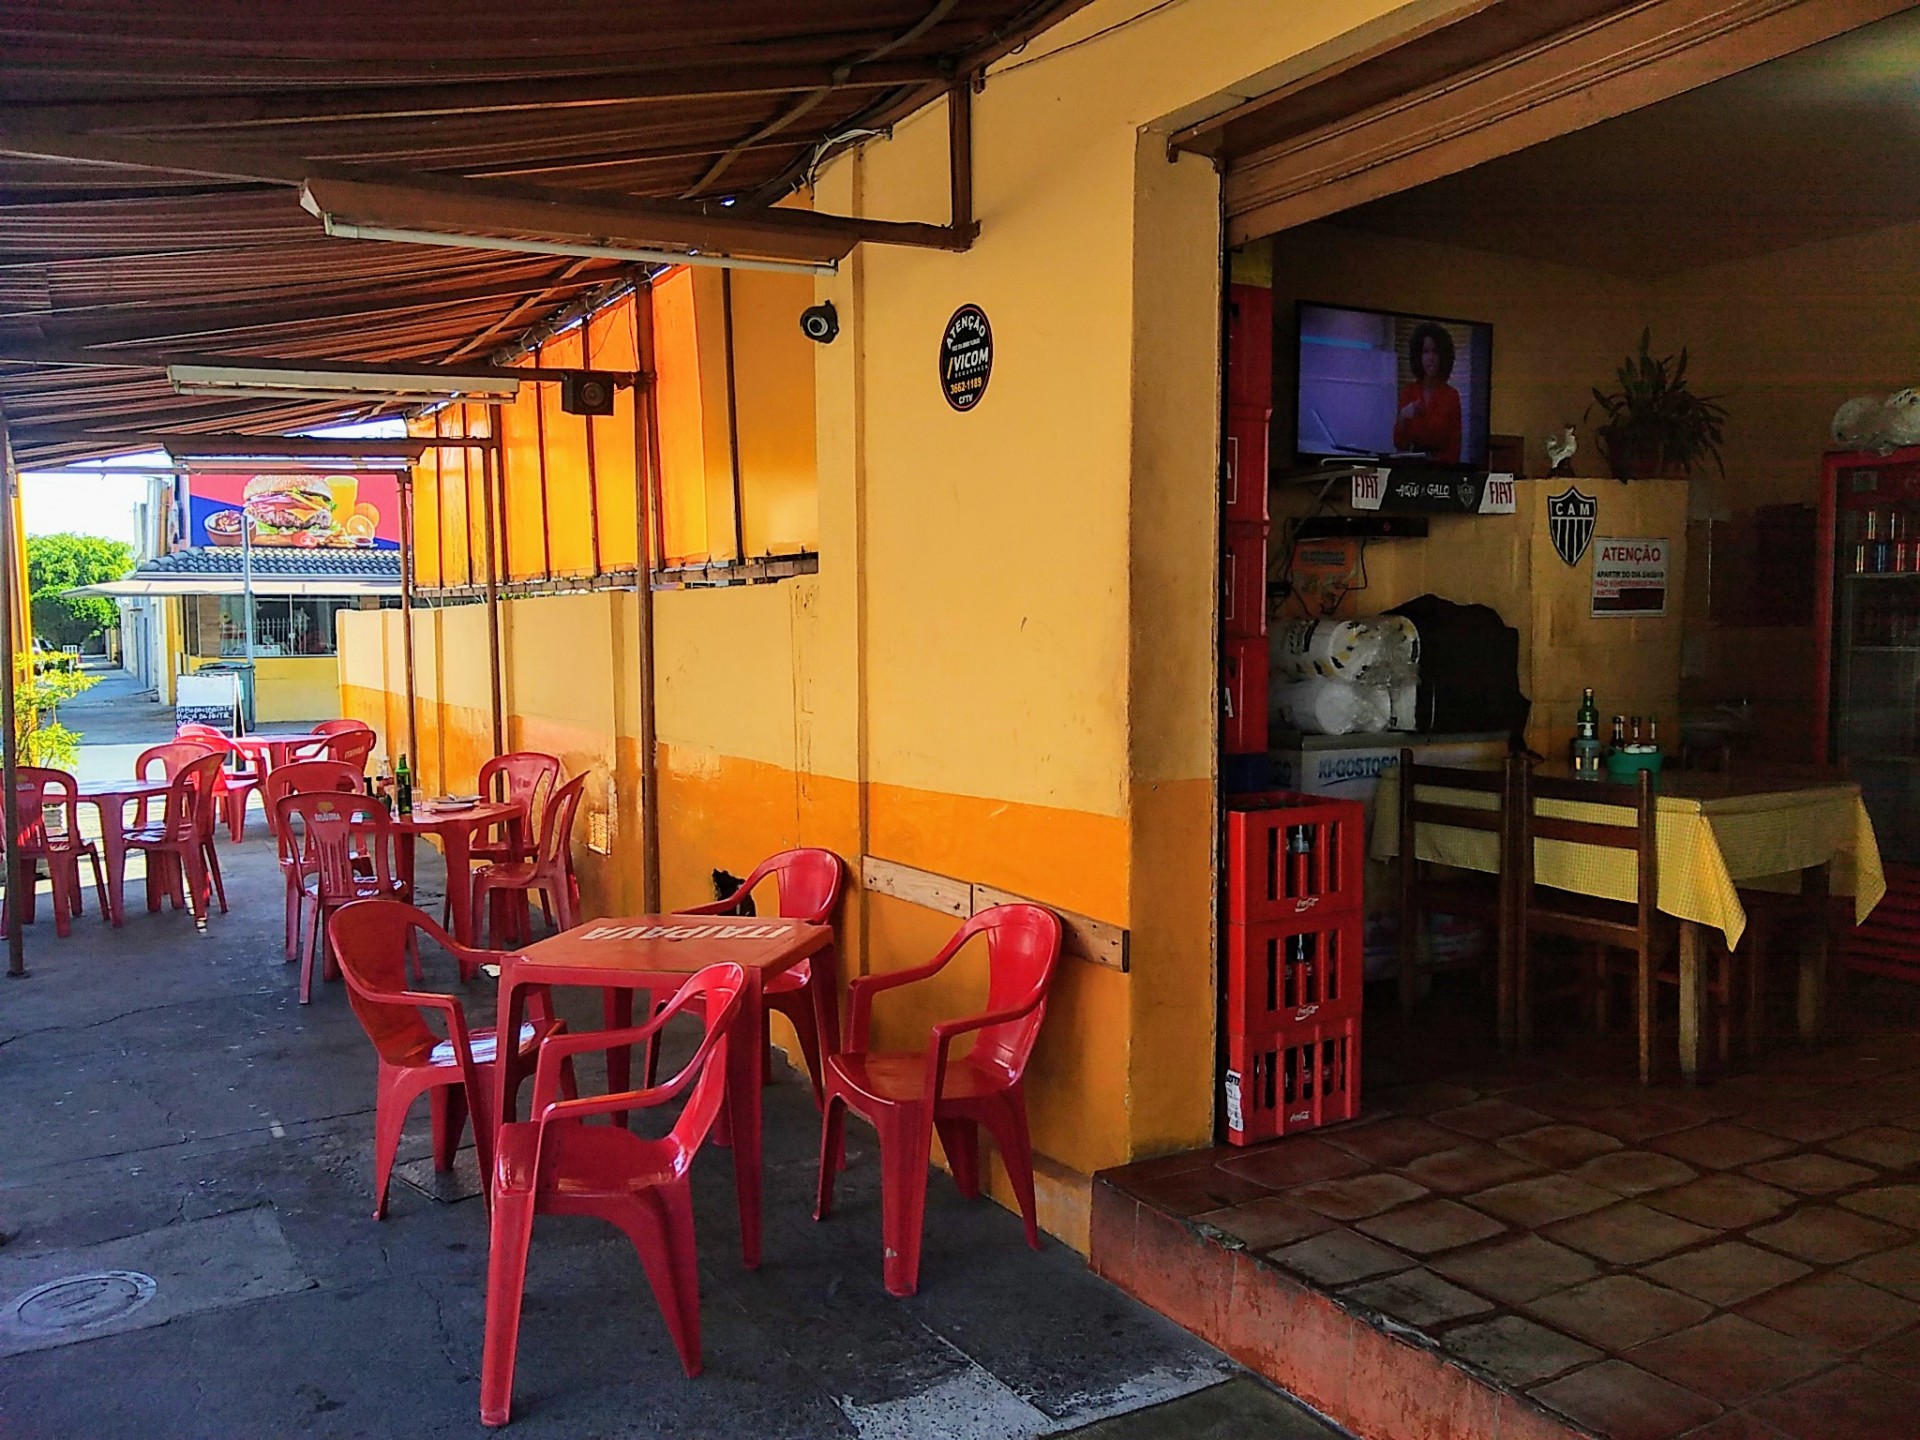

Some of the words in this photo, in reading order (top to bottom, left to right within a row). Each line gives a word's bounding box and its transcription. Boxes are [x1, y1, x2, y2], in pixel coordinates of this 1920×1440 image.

[946, 315, 986, 350] ATENÇÃO
[953, 346, 989, 371] VICOM
[1355, 475, 1379, 499] FIAT
[1427, 484, 1450, 497] GALO
[1489, 481, 1513, 504] FIAT
[1601, 544, 1661, 565] ATENÇÃO
[579, 925, 794, 940] ITAIPAVA
